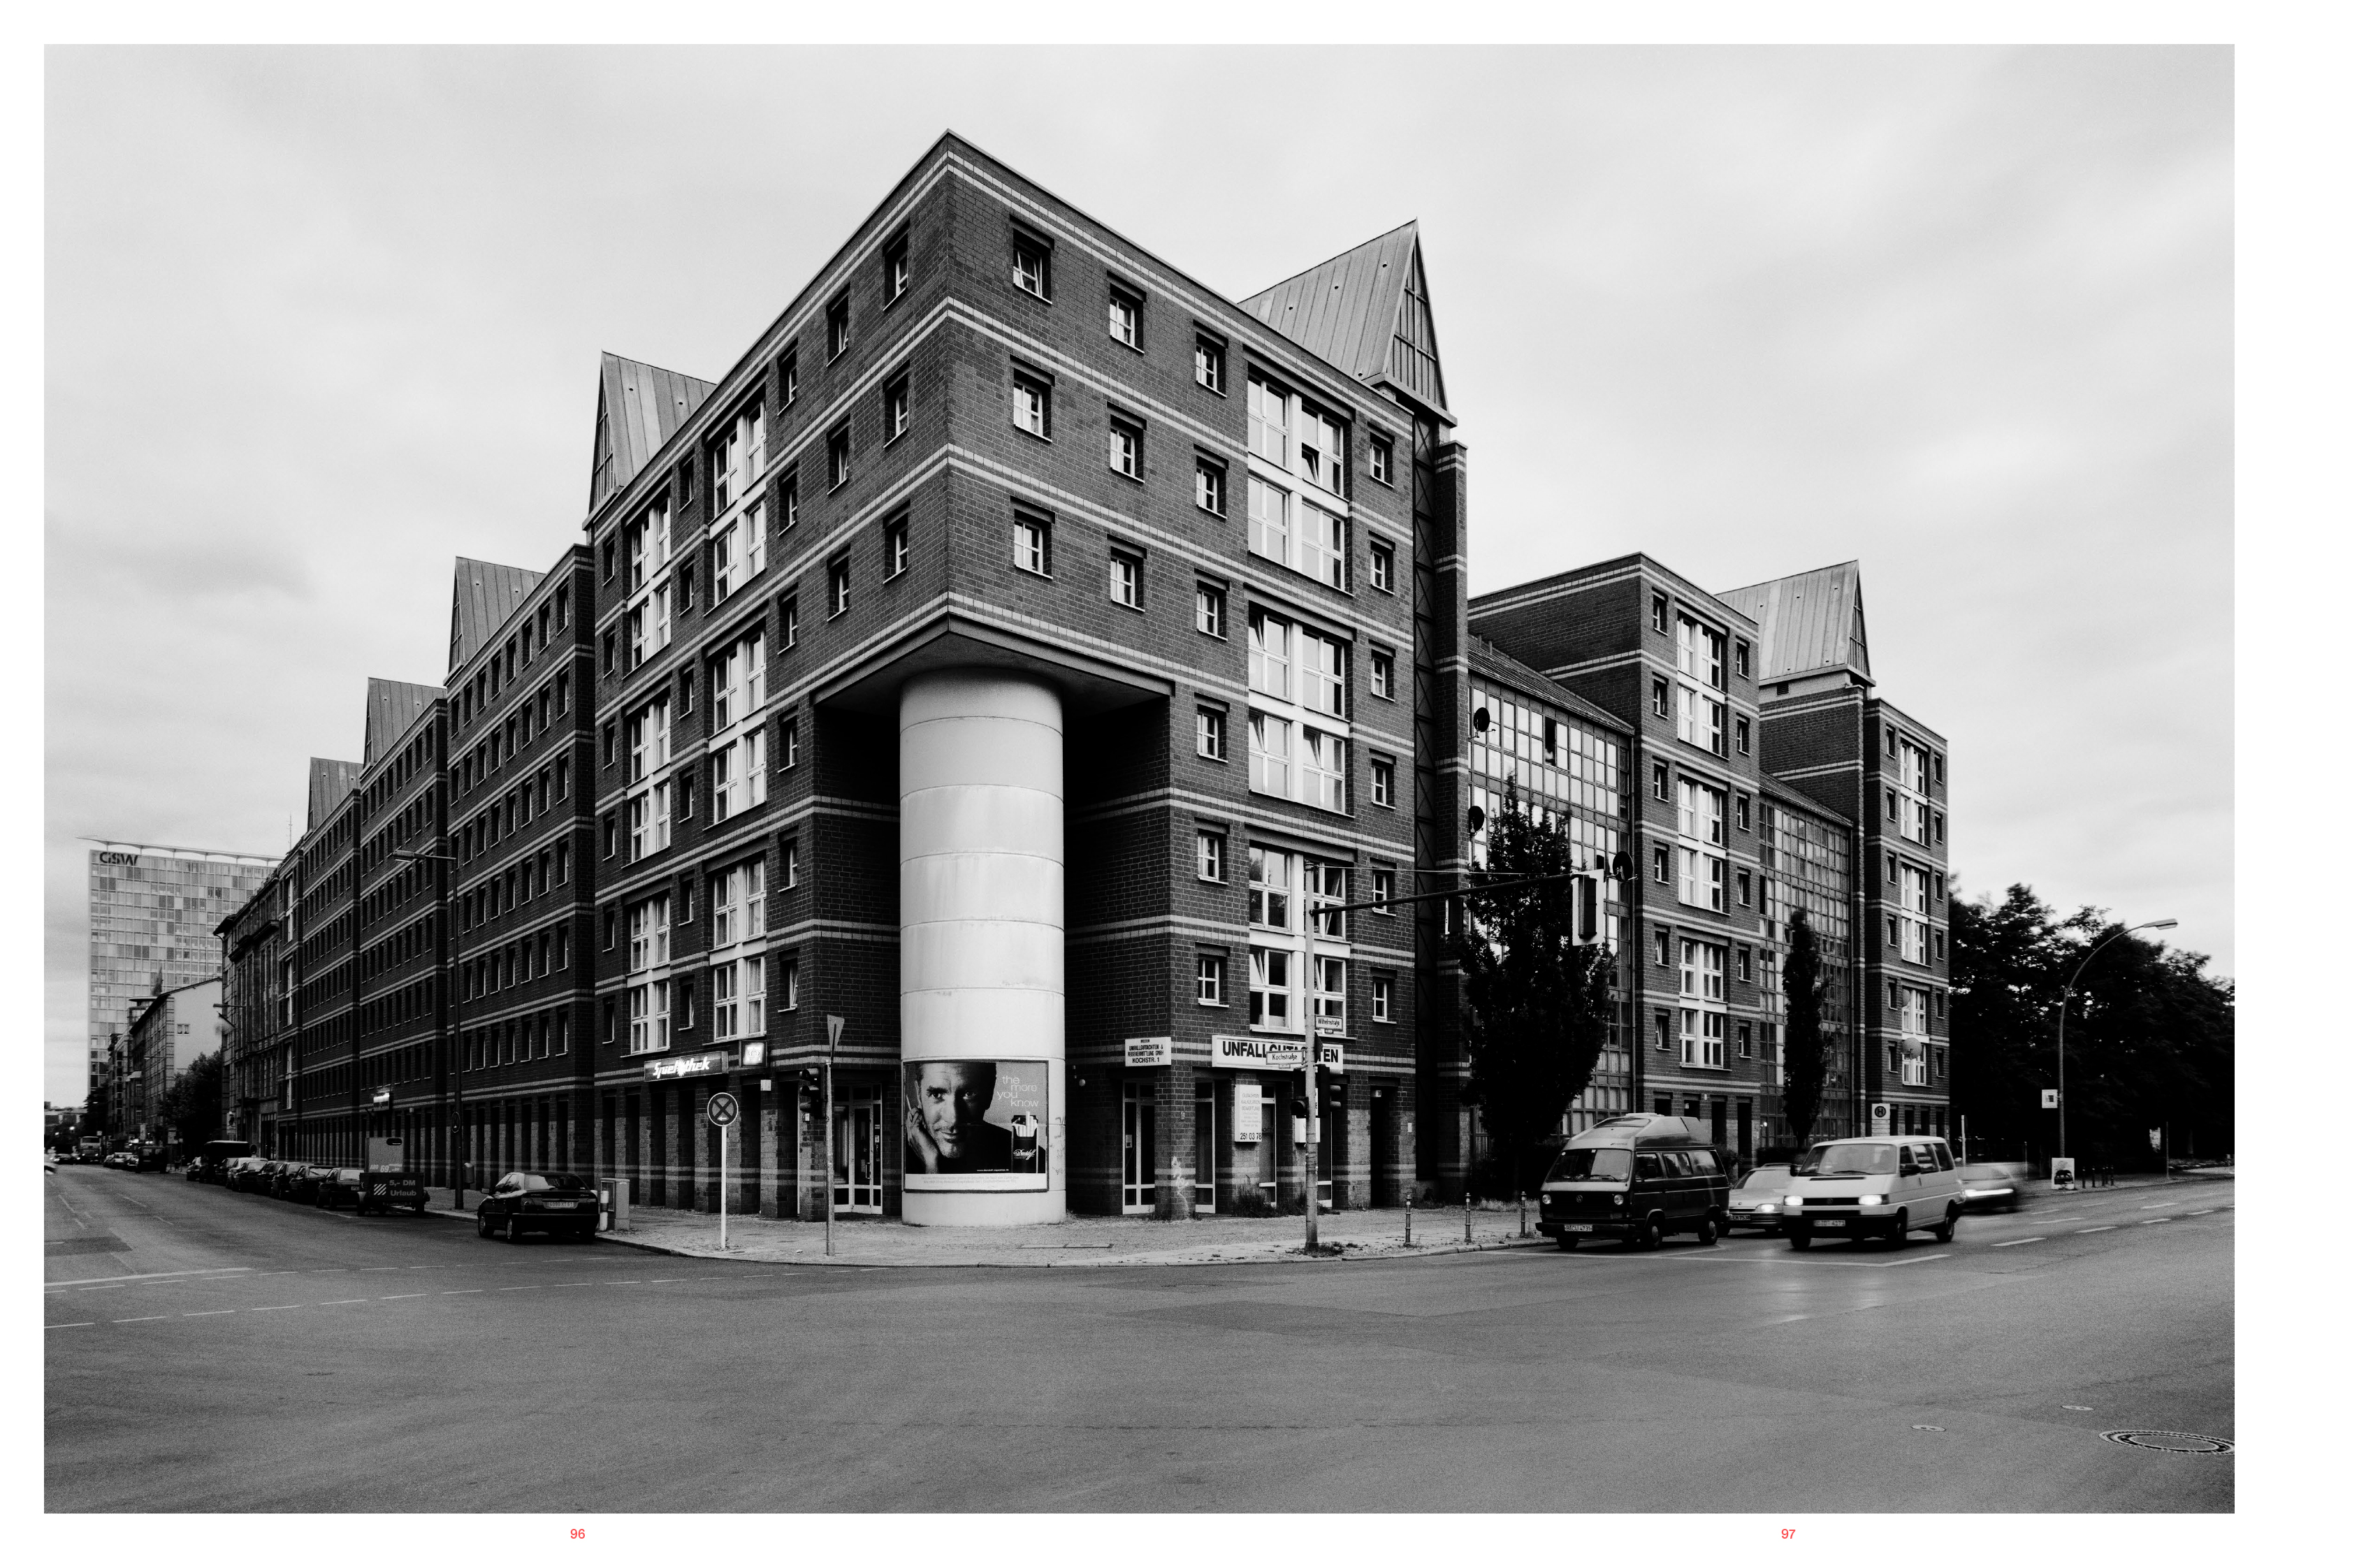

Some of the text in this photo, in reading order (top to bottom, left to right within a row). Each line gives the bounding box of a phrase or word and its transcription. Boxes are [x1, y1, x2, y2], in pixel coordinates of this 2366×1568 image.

[99, 852, 138, 866] GSW
[1001, 1075, 1020, 1084] the
[996, 1091, 1018, 1101] you
[1010, 1098, 1039, 1107] know
[1240, 1132, 1262, 1140] 251 03 78
